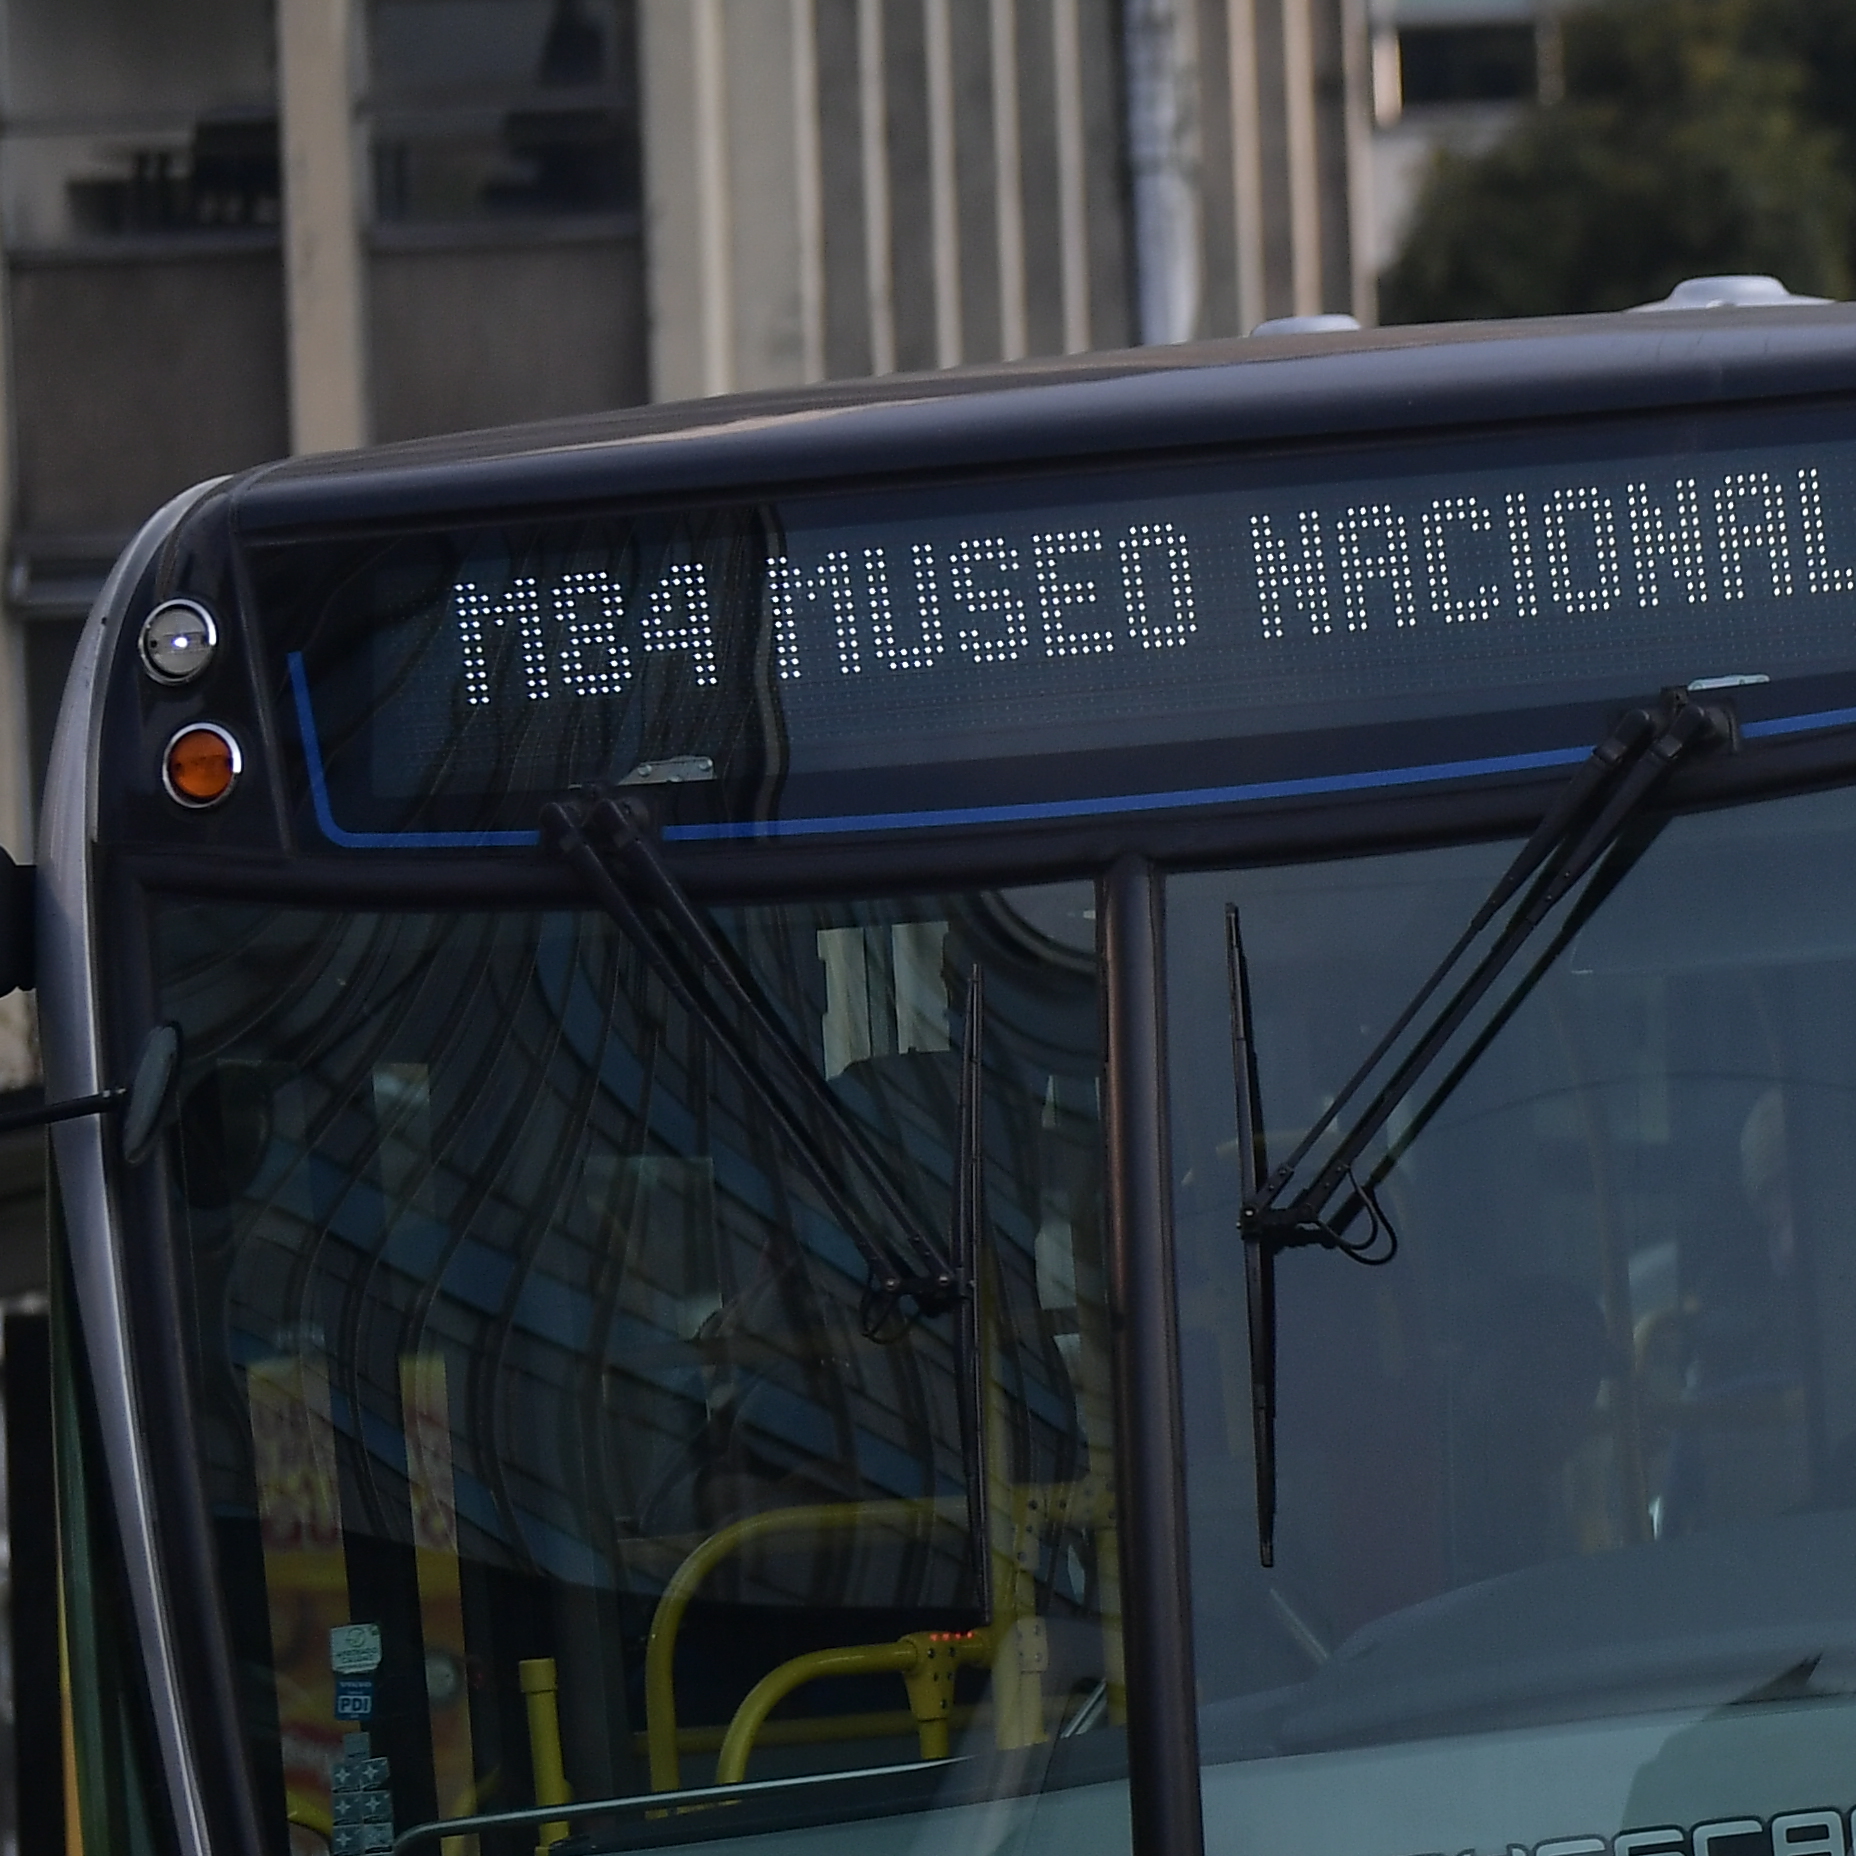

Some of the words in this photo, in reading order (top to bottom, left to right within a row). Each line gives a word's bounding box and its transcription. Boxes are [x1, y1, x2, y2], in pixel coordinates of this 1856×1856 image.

[453, 562, 718, 705] M84
[766, 522, 1197, 679] MUSEO
[341, 1697, 368, 1711] PDI
